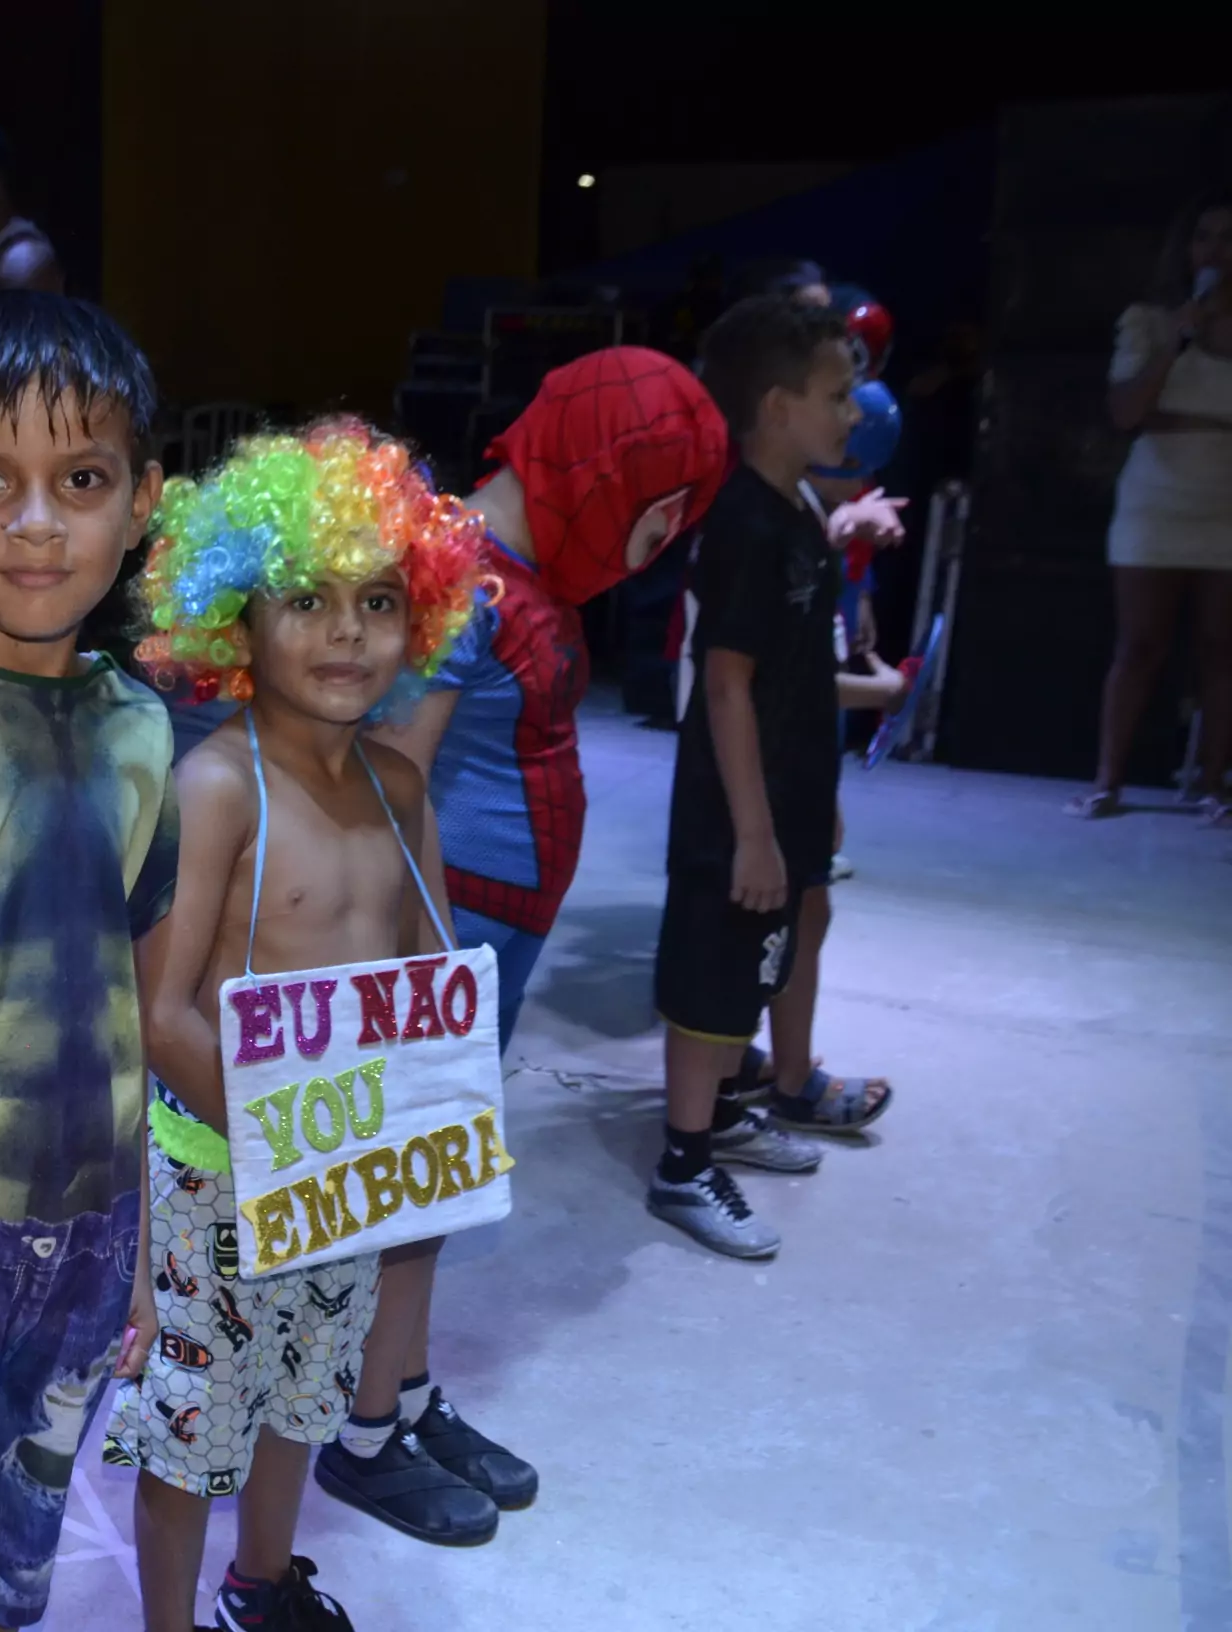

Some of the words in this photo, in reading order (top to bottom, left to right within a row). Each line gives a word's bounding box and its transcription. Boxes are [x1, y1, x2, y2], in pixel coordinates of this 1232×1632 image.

[228, 979, 338, 1066] EU
[350, 956, 478, 1046] NÃO
[240, 1106, 516, 1275] EMBORA
